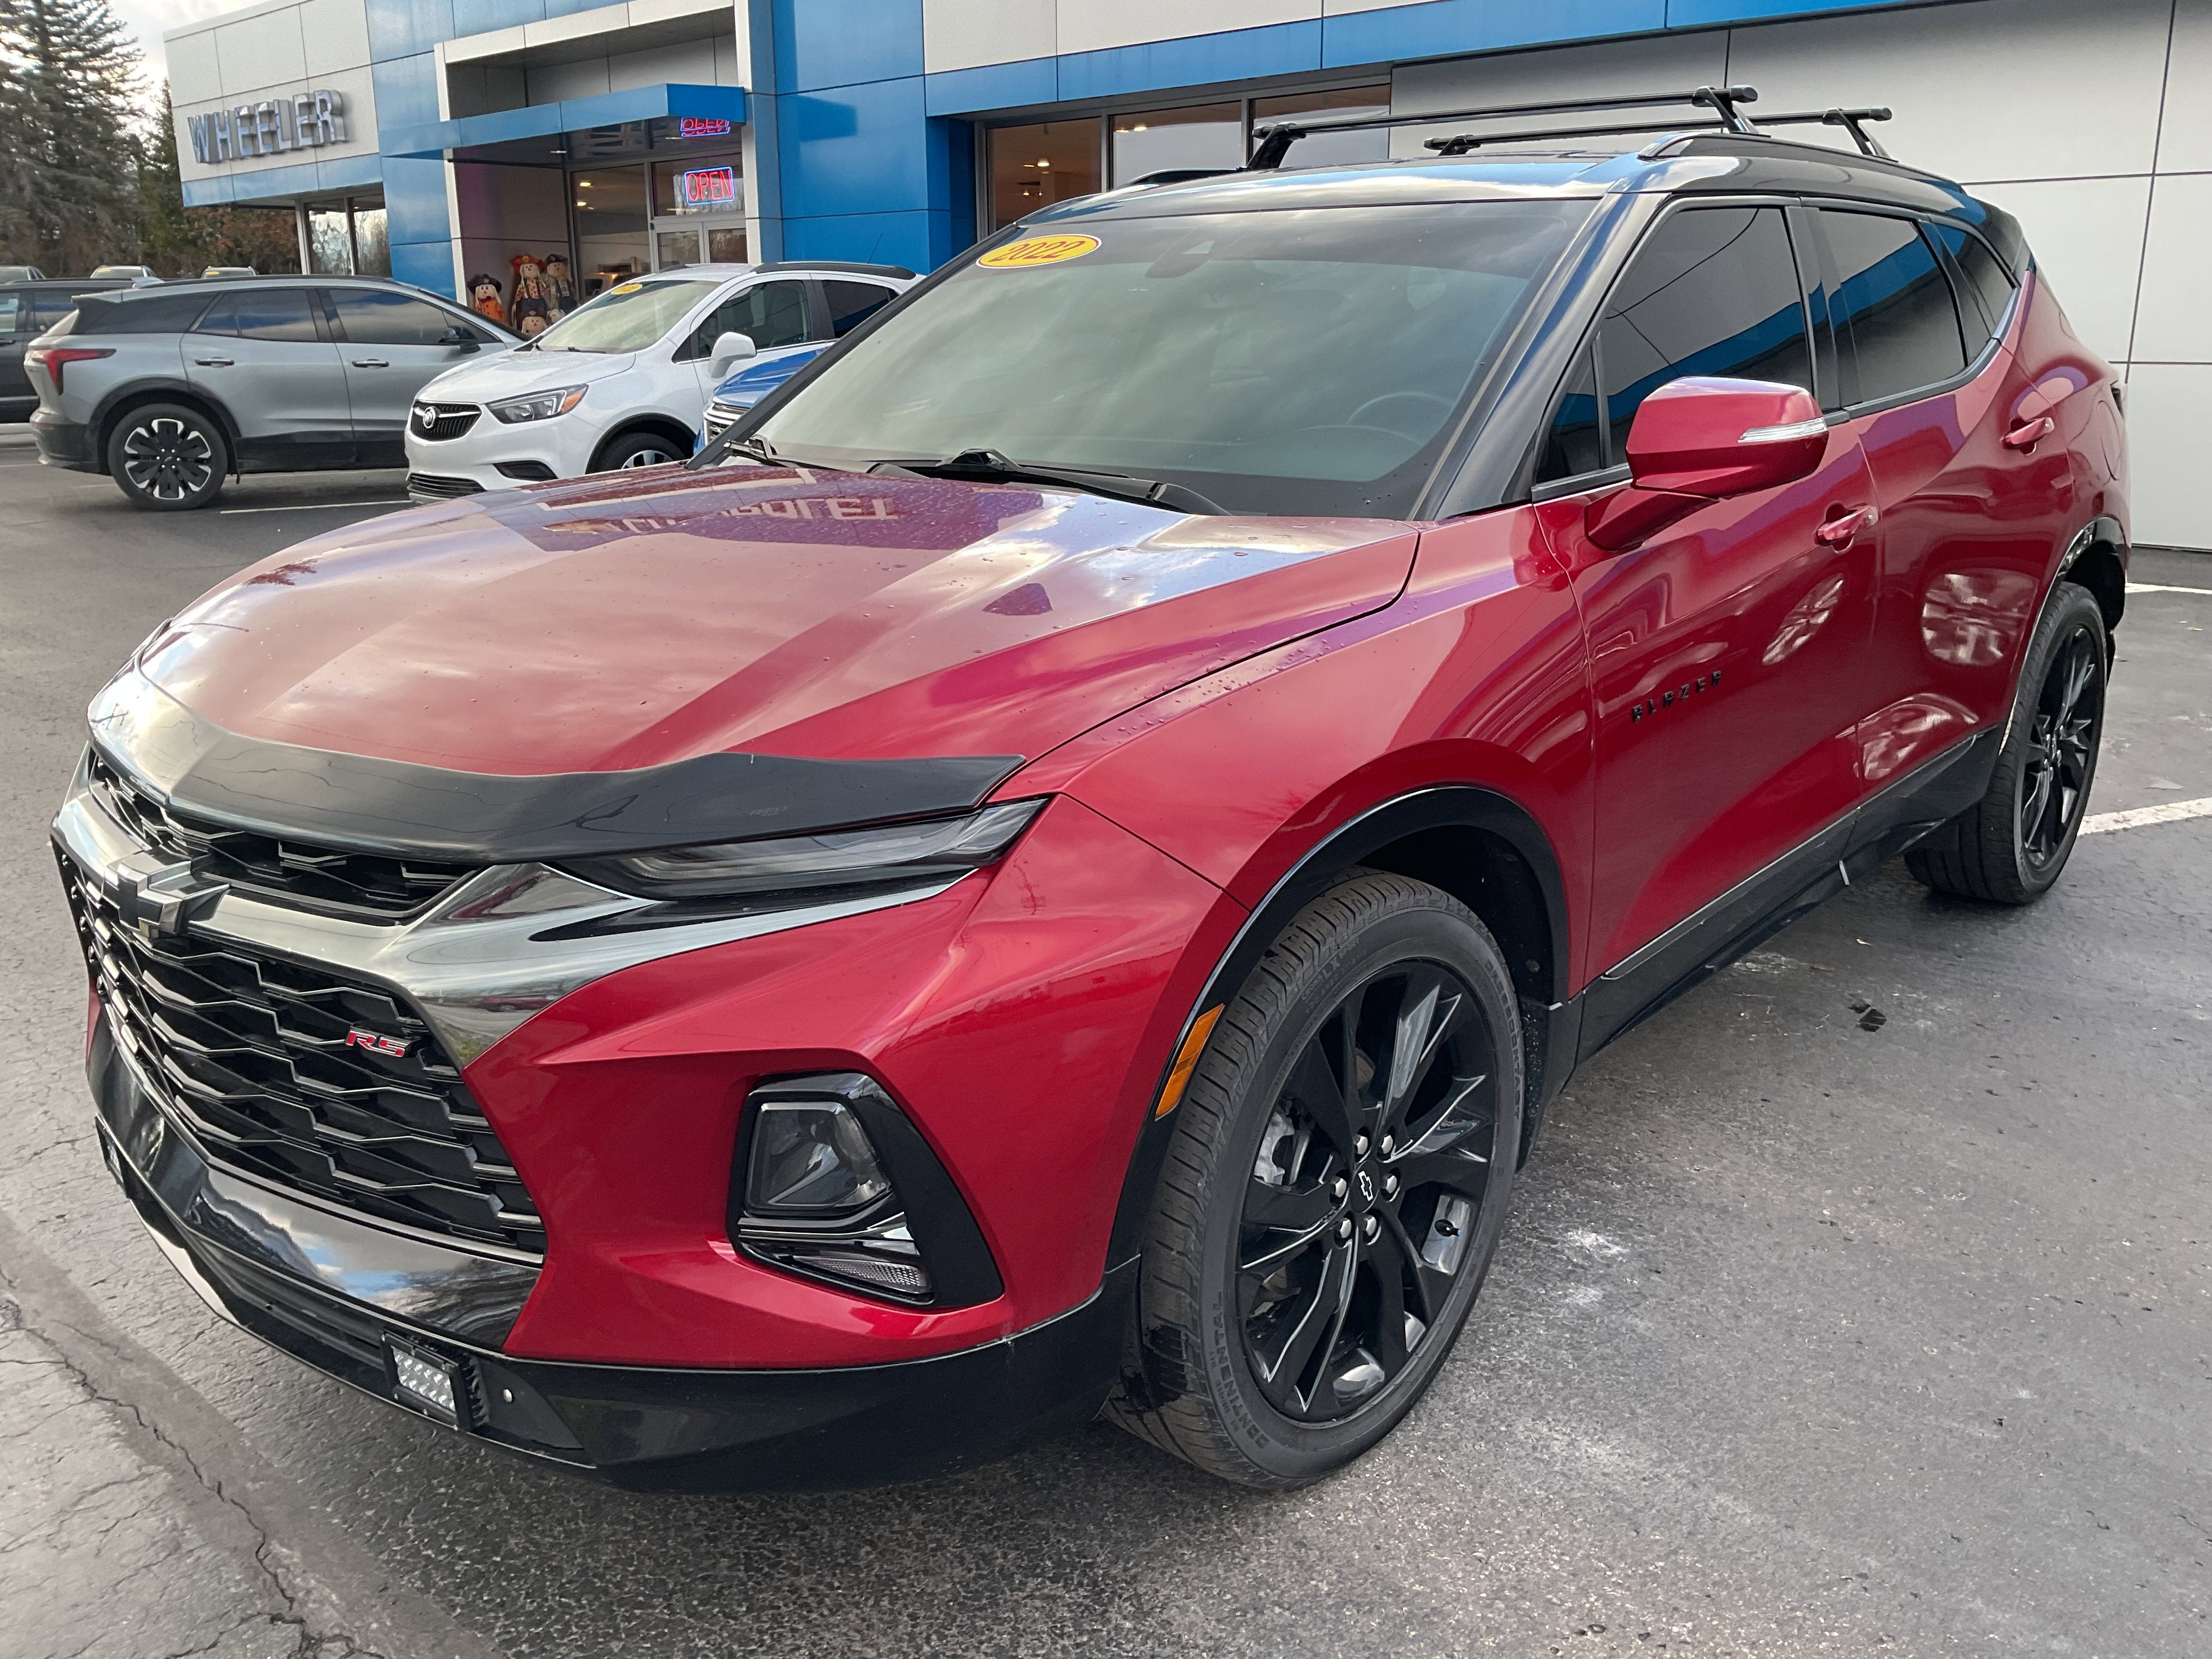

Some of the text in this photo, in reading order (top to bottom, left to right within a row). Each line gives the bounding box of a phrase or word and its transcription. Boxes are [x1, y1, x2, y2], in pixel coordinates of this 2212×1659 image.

[187, 89, 346, 163] WHEELER
[687, 170, 733, 201] OPEN
[988, 241, 1086, 262] 2022
[1633, 670, 1722, 724] BLAZER
[346, 1030, 408, 1058] RS
[1212, 1291, 1269, 1449] CONTINENTAL
